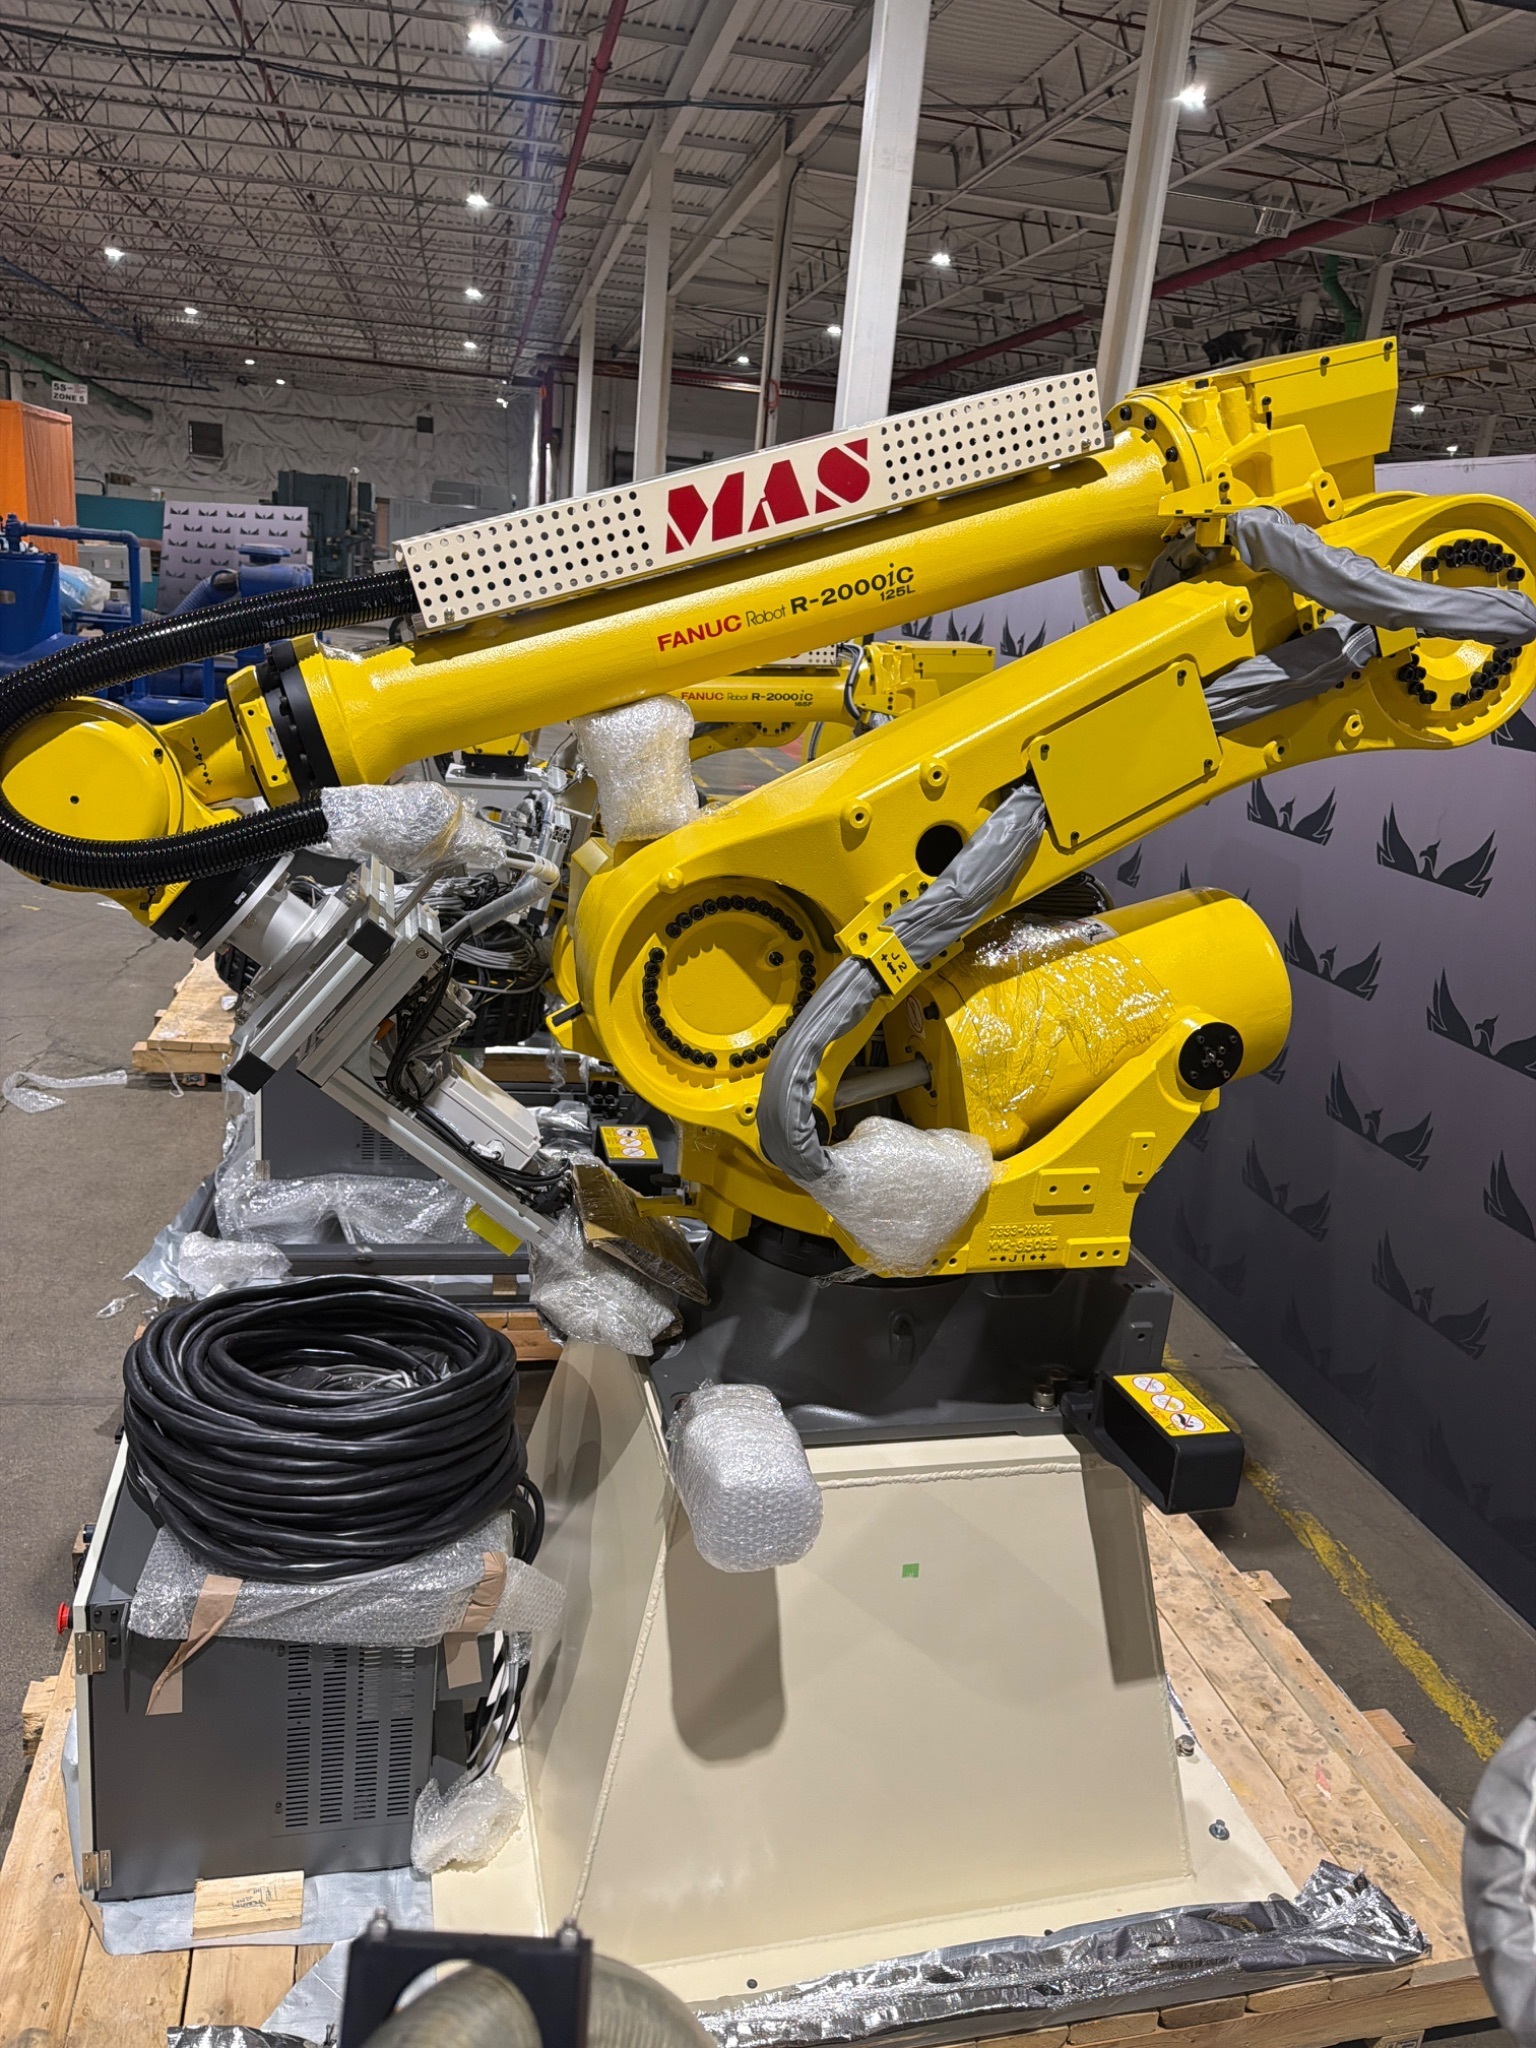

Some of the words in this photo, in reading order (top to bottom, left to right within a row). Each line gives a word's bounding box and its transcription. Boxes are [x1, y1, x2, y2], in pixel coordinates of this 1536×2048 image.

[54, 393, 77, 401] ZONE
[665, 438, 870, 554] MAS
[880, 586, 916, 602] 125L
[657, 615, 742, 652] FANUC
[746, 605, 786, 628] Robot
[790, 563, 915, 615] R-2000iC
[681, 691, 724, 701] FANUC
[726, 692, 749, 701] Robot
[751, 690, 814, 701] R-2000iC
